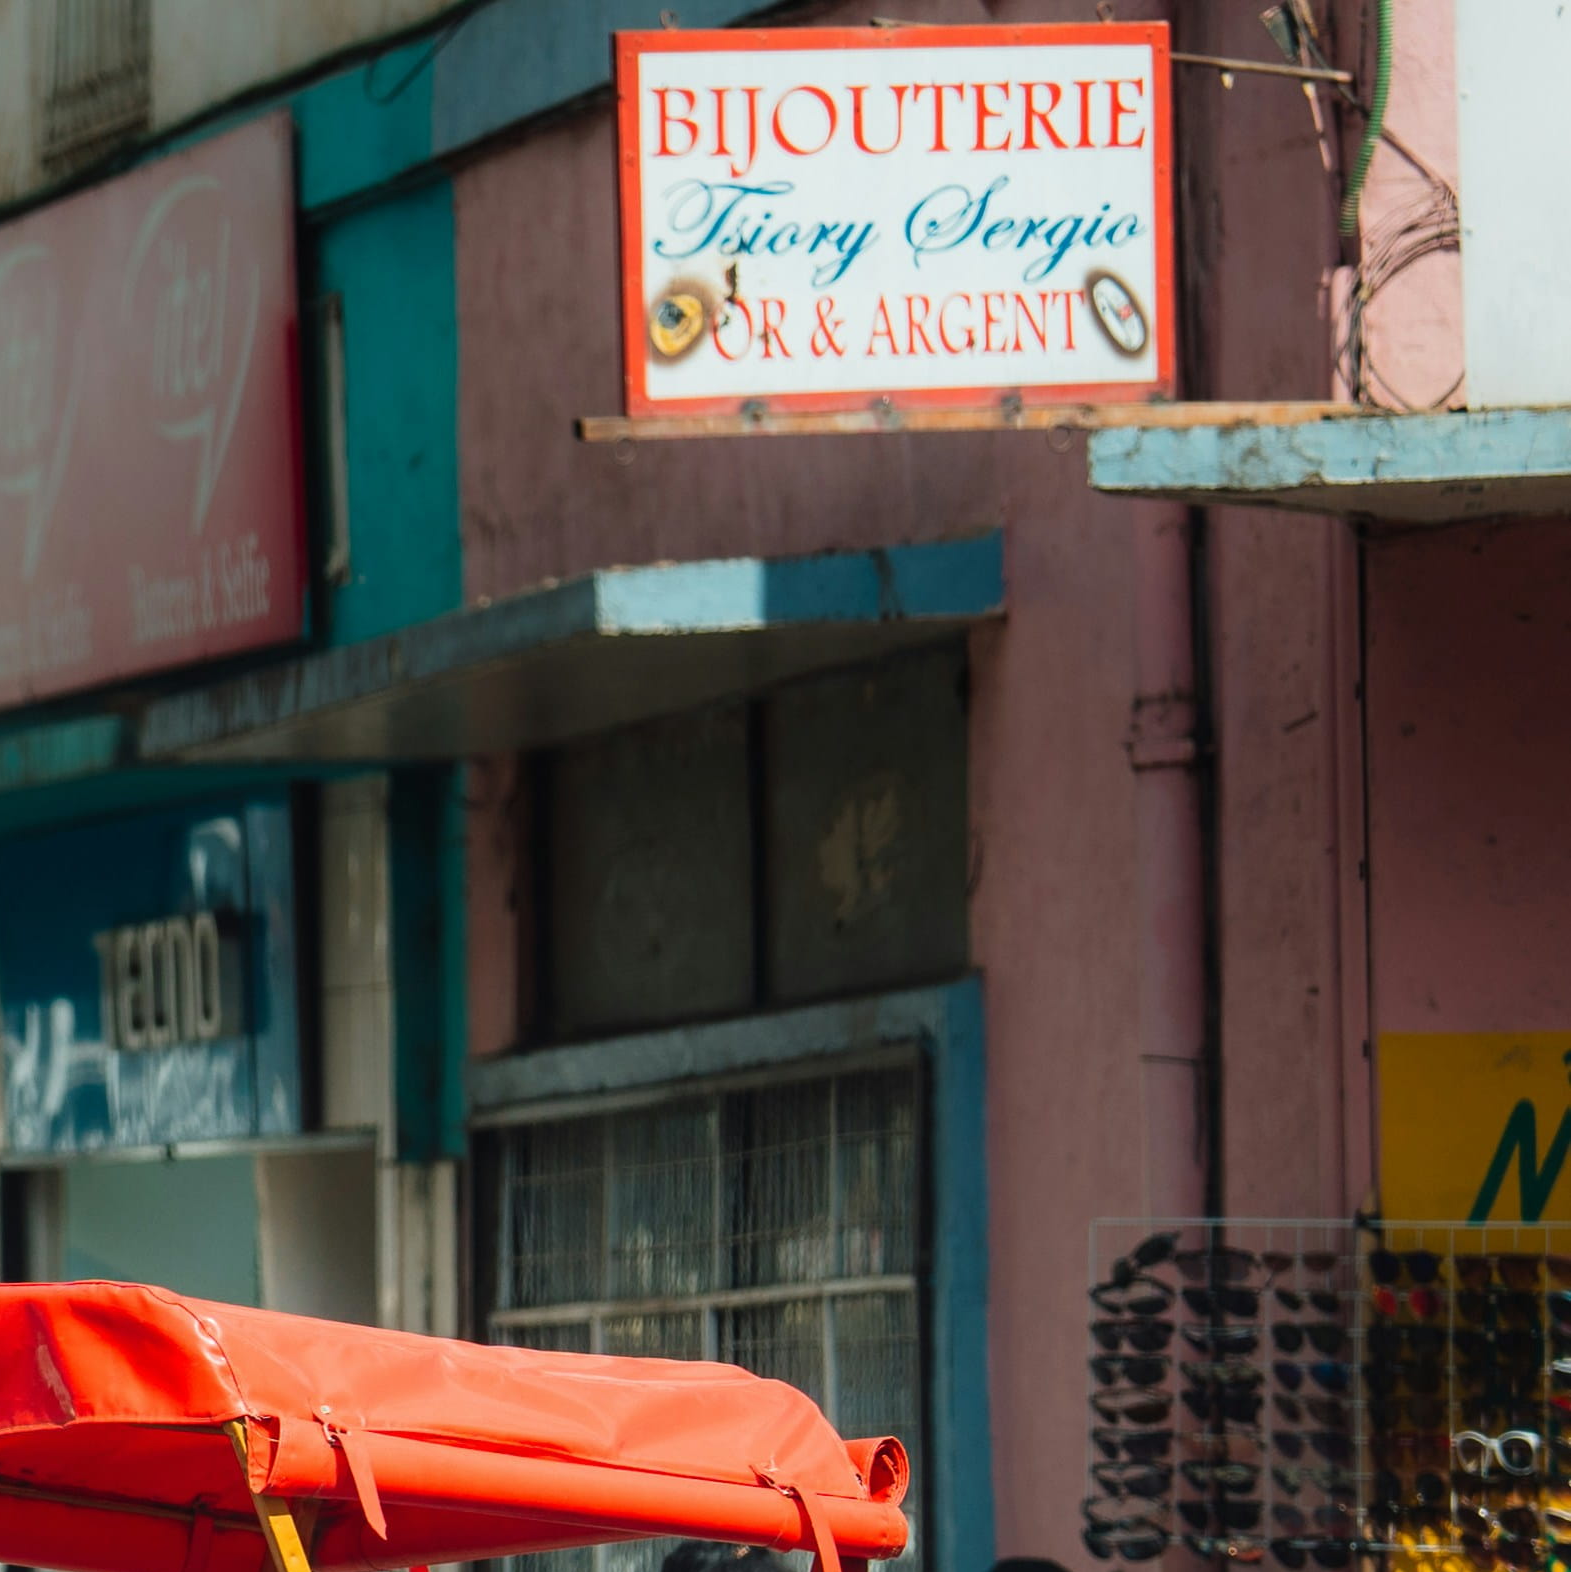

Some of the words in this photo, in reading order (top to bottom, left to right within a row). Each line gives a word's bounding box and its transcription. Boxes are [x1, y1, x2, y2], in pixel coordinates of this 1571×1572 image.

[652, 77, 1146, 176] BIJOUTERIE
[653, 178, 879, 288] Tsiory
[905, 175, 1145, 284] Sergio
[712, 292, 791, 362] OR
[810, 295, 847, 358] &
[866, 289, 1086, 358] ARGENT
